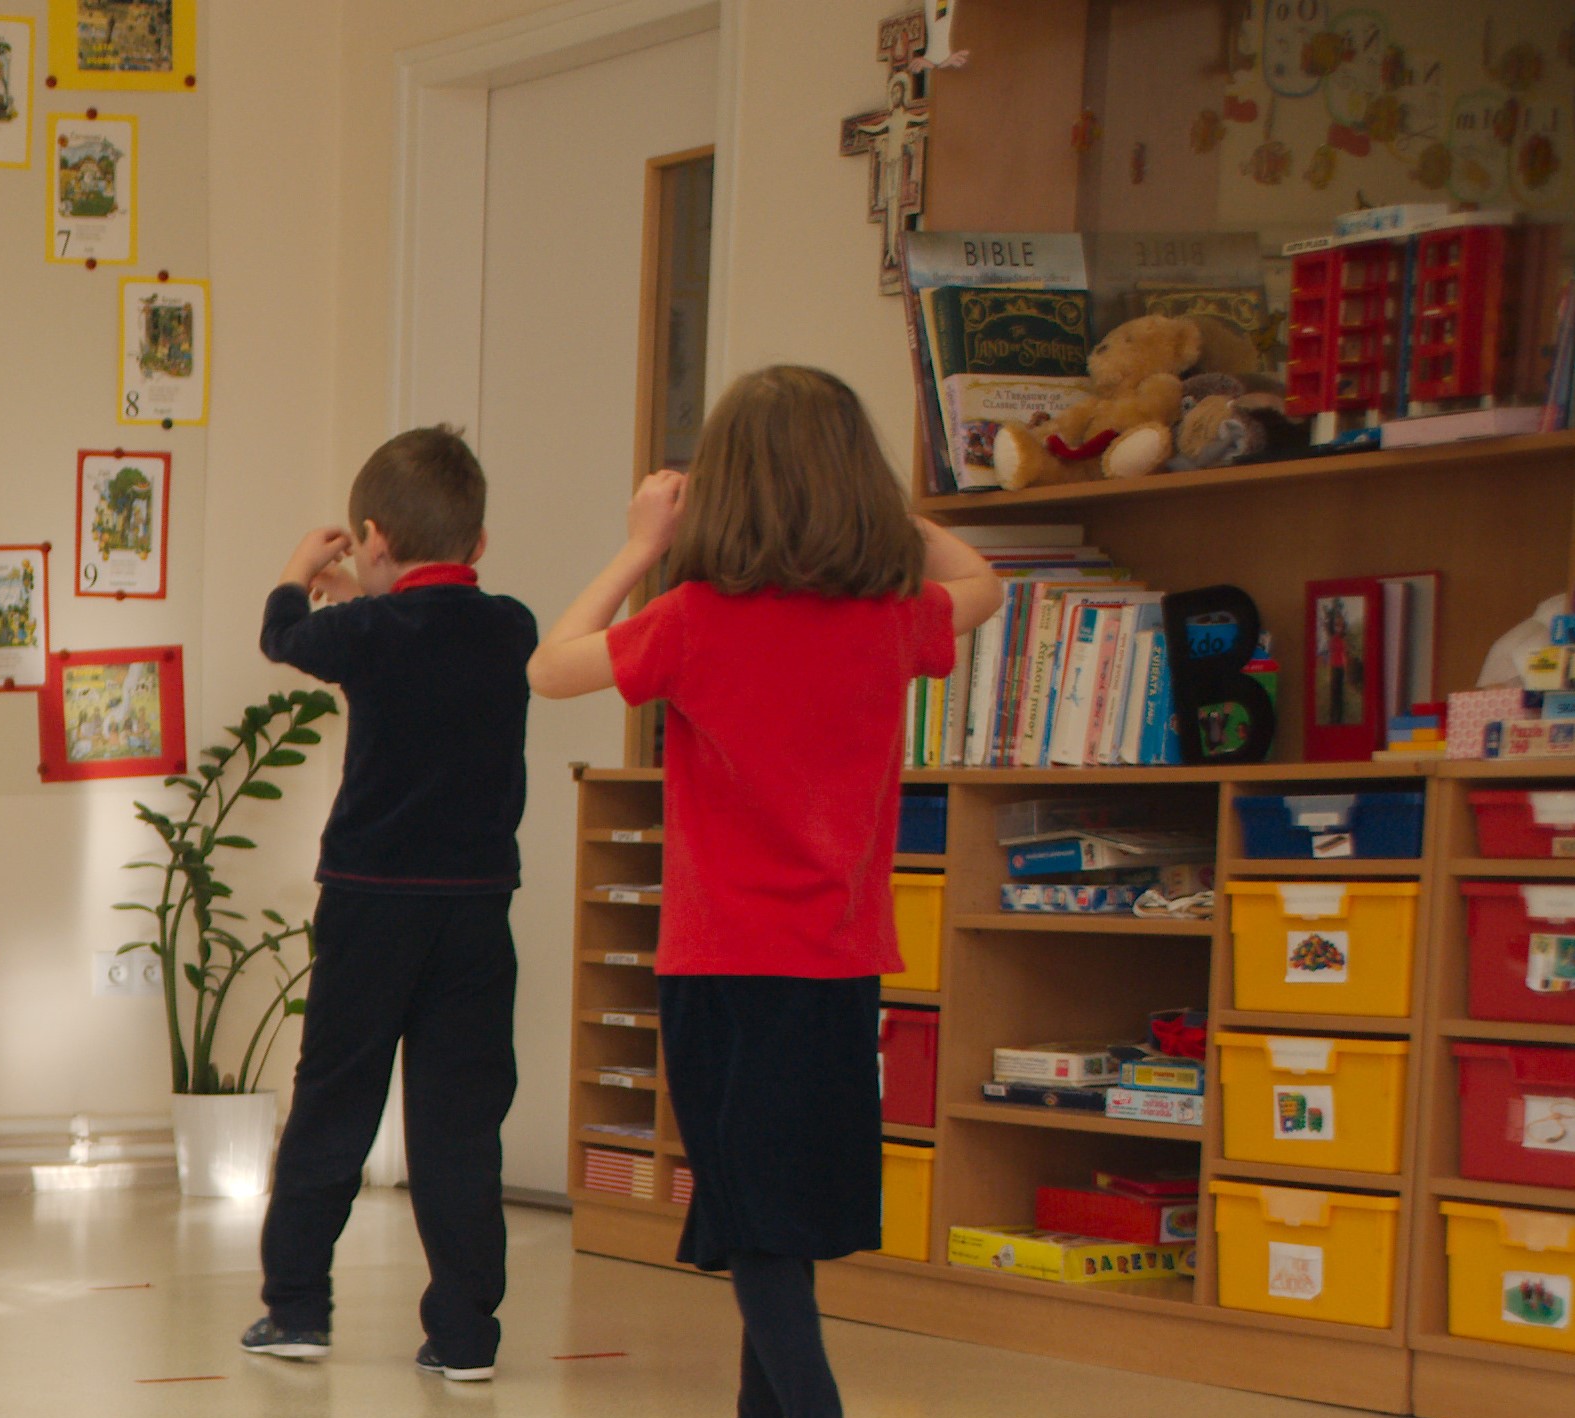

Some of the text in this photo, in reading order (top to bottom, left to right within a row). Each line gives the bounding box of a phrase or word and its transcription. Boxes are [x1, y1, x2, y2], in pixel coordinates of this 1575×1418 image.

[57, 229, 72, 257] 7
[963, 240, 1036, 268] BIBLE
[125, 390, 139, 417] 8
[83, 563, 99, 589] 9
